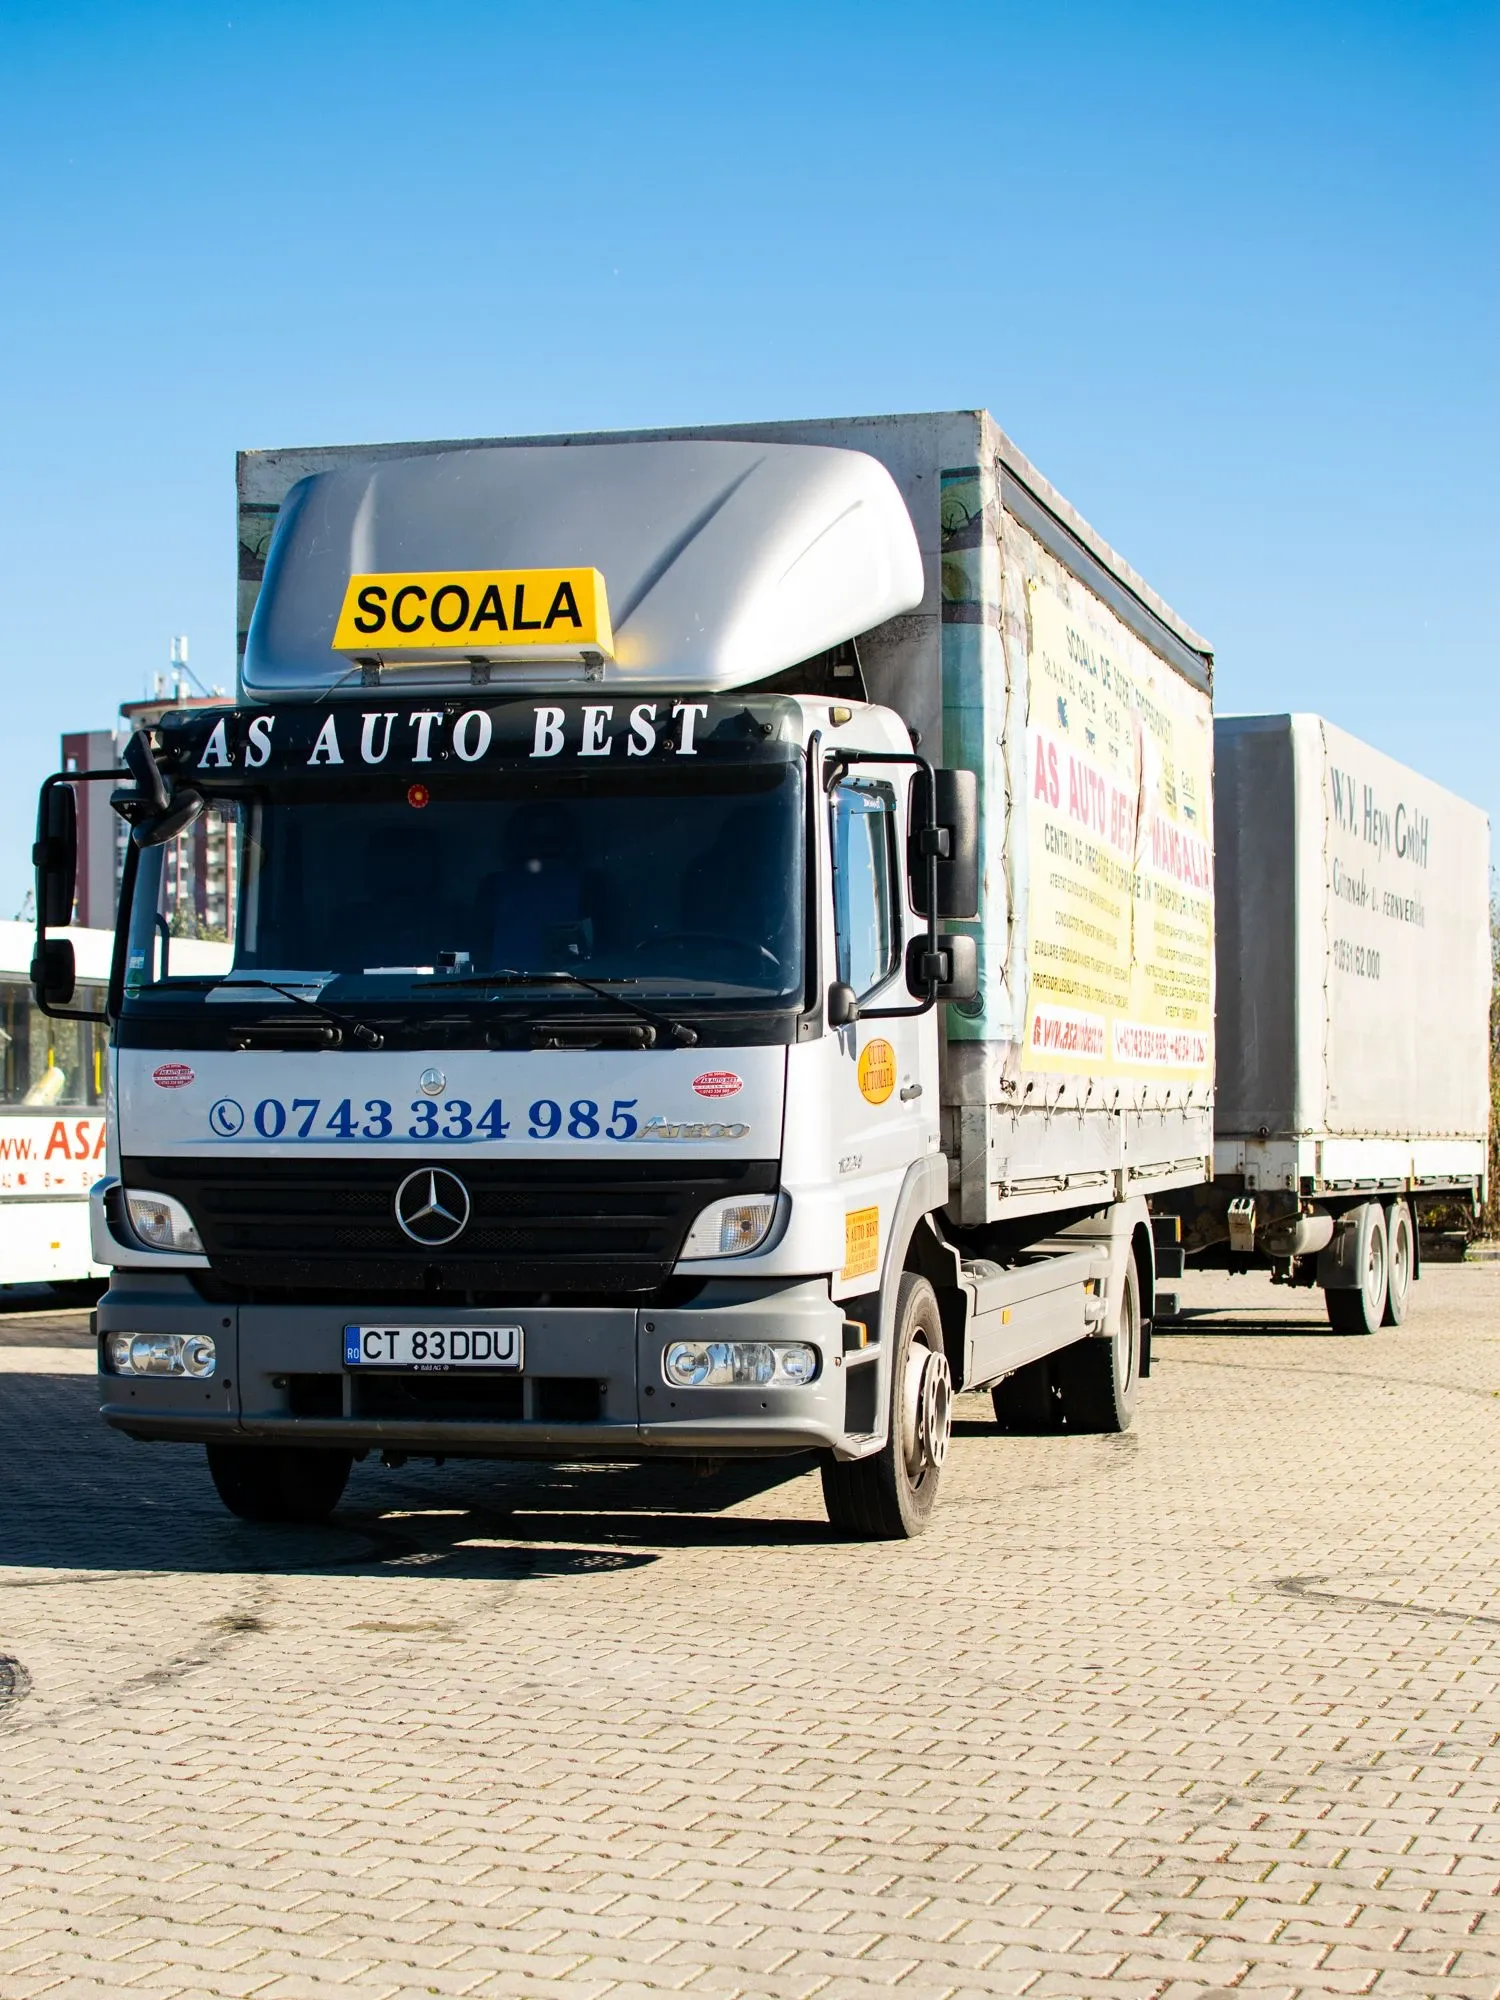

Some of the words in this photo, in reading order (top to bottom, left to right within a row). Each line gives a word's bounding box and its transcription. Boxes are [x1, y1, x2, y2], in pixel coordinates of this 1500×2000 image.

[354, 581, 583, 633] SCOALA
[197, 715, 275, 769] AS
[306, 709, 494, 765] AUTO
[529, 704, 709, 758] BEST
[1034, 735, 1060, 809] AS
[1069, 755, 1106, 836] AUTO
[1110, 787, 1135, 856] BES
[253, 1099, 393, 1139] 0743
[408, 1099, 511, 1139] 334
[527, 1099, 639, 1139] 985
[347, 1347, 361, 1360] RO
[363, 1331, 400, 1360] CT
